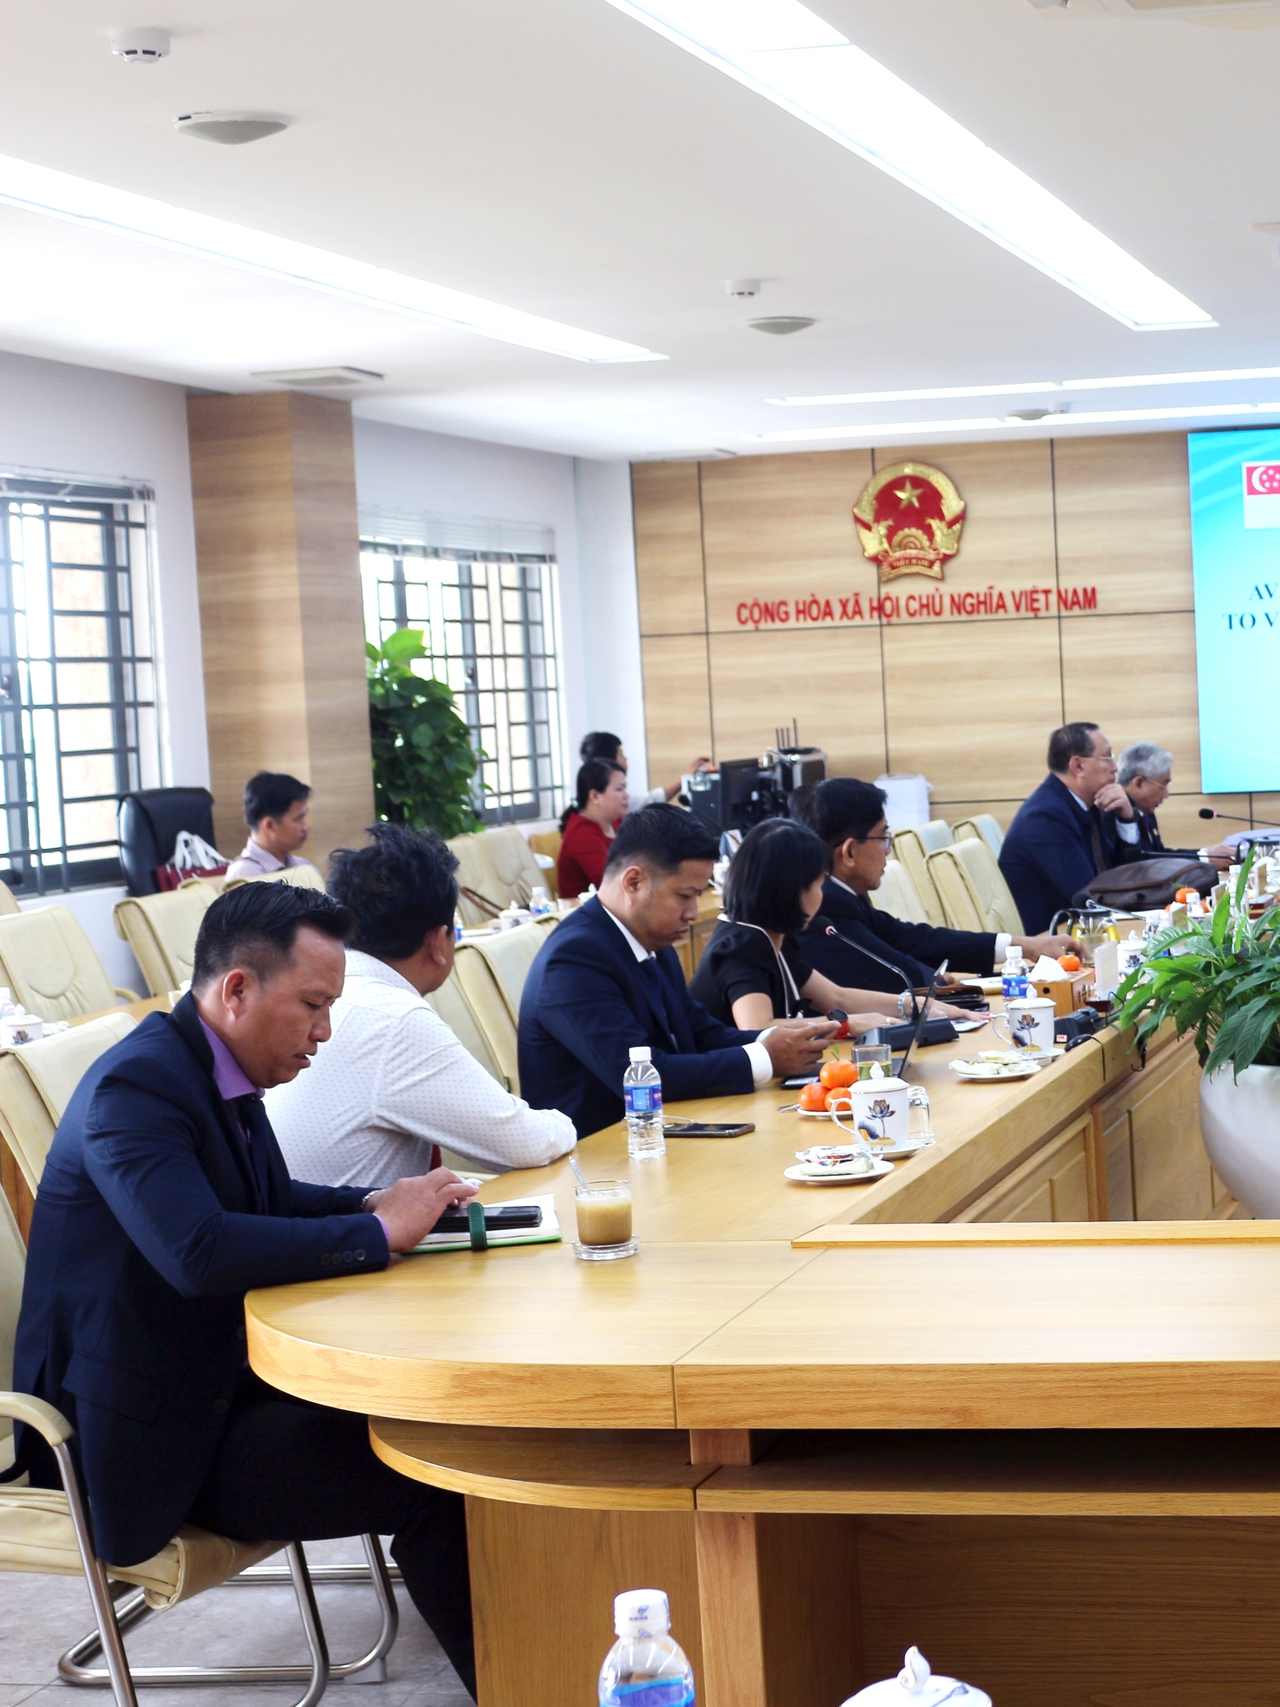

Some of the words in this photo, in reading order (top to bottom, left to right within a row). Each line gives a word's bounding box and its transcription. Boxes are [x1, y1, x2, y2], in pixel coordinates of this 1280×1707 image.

[736, 597, 790, 631] CỘNG
[795, 592, 834, 622] HÒA
[839, 591, 864, 621] XÃ
[869, 591, 901, 626] HỘI
[905, 587, 943, 617] CHỦ
[950, 585, 1008, 616] NGHĨA
[1011, 585, 1053, 618] VIỆT
[1056, 586, 1097, 611] NAM
[1222, 612, 1257, 631] TO
